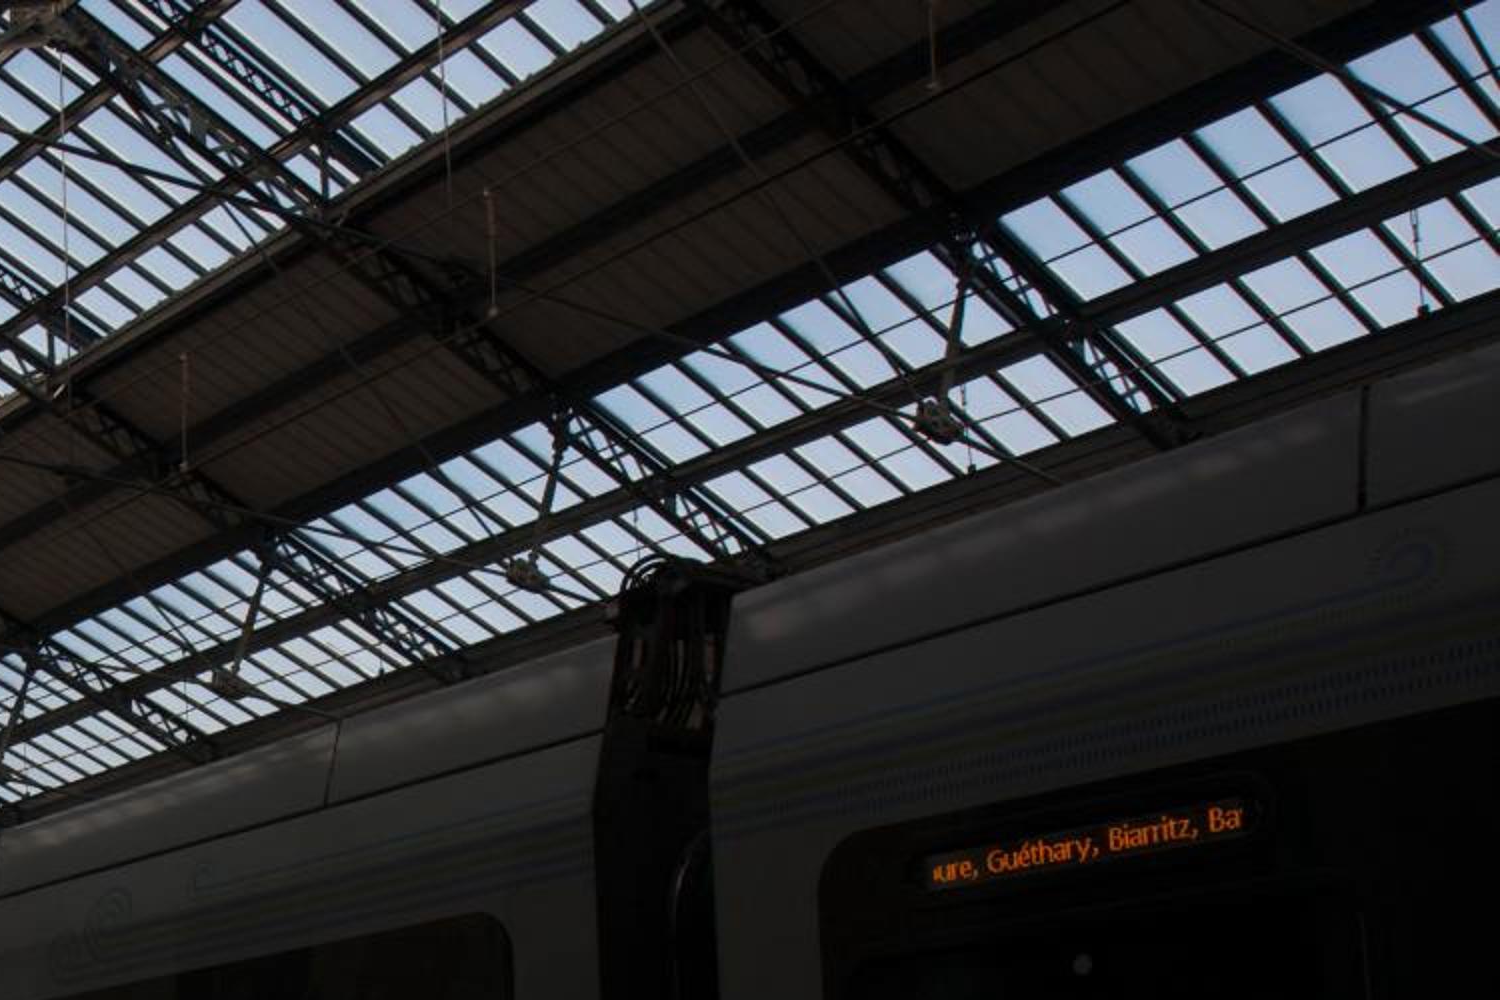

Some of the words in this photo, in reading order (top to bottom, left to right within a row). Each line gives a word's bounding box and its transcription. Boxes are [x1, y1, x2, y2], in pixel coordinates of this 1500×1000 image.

[987, 836, 1099, 874] Guéthary,
[1108, 816, 1198, 852] Biarritz,
[1208, 806, 1243, 833] Ba
